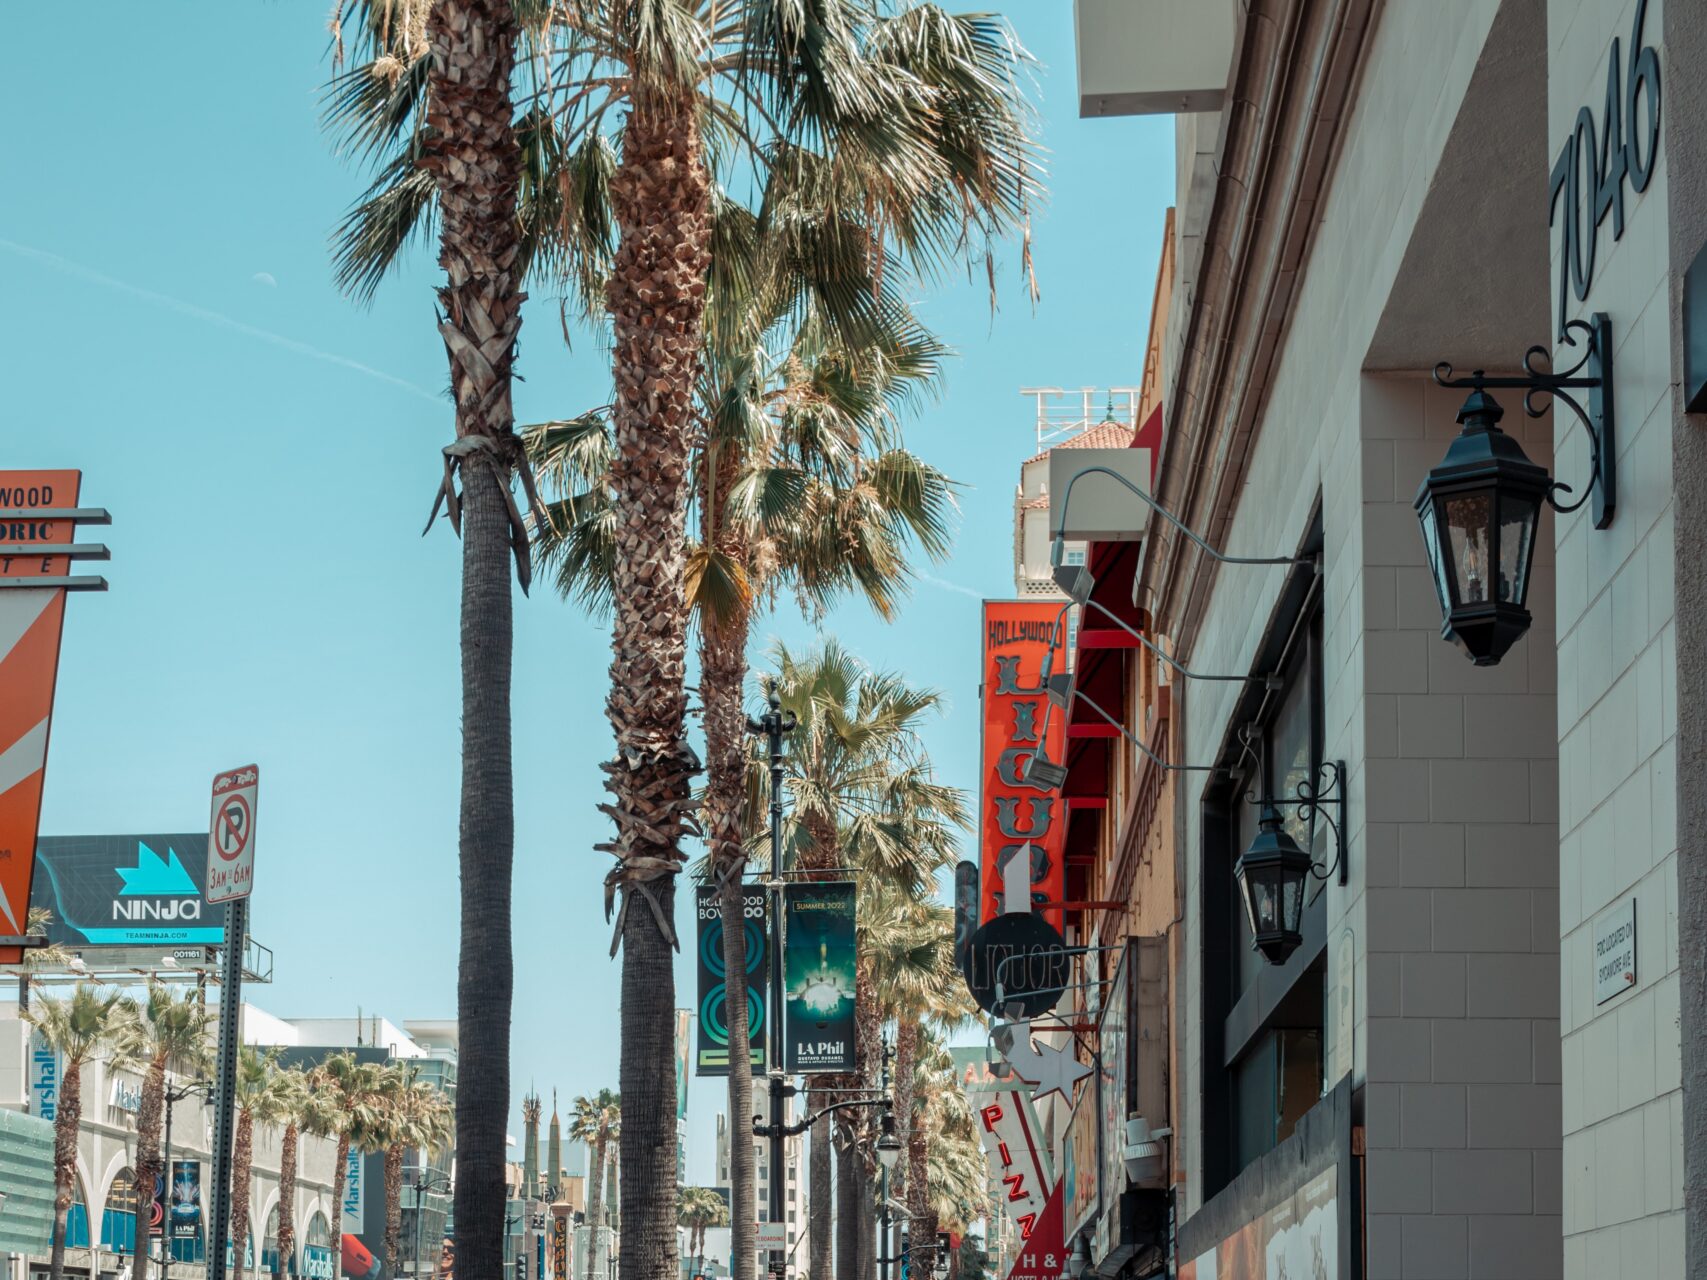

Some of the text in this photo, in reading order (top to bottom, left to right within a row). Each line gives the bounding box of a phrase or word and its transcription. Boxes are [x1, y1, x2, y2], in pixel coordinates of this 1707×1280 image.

[1549, 0, 1660, 344] 7046
[988, 621, 1062, 651] HOLLYWOOD
[210, 868, 226, 889] 3AM
[234, 863, 250, 884] 6AM
[1606, 926, 1625, 952] LOCATED
[1626, 921, 1633, 939] ON
[971, 944, 1065, 990] LIQUOR
[798, 1041, 844, 1055] LA Phil
[1023, 1254, 1036, 1268] H
[1044, 1253, 1057, 1268] &
